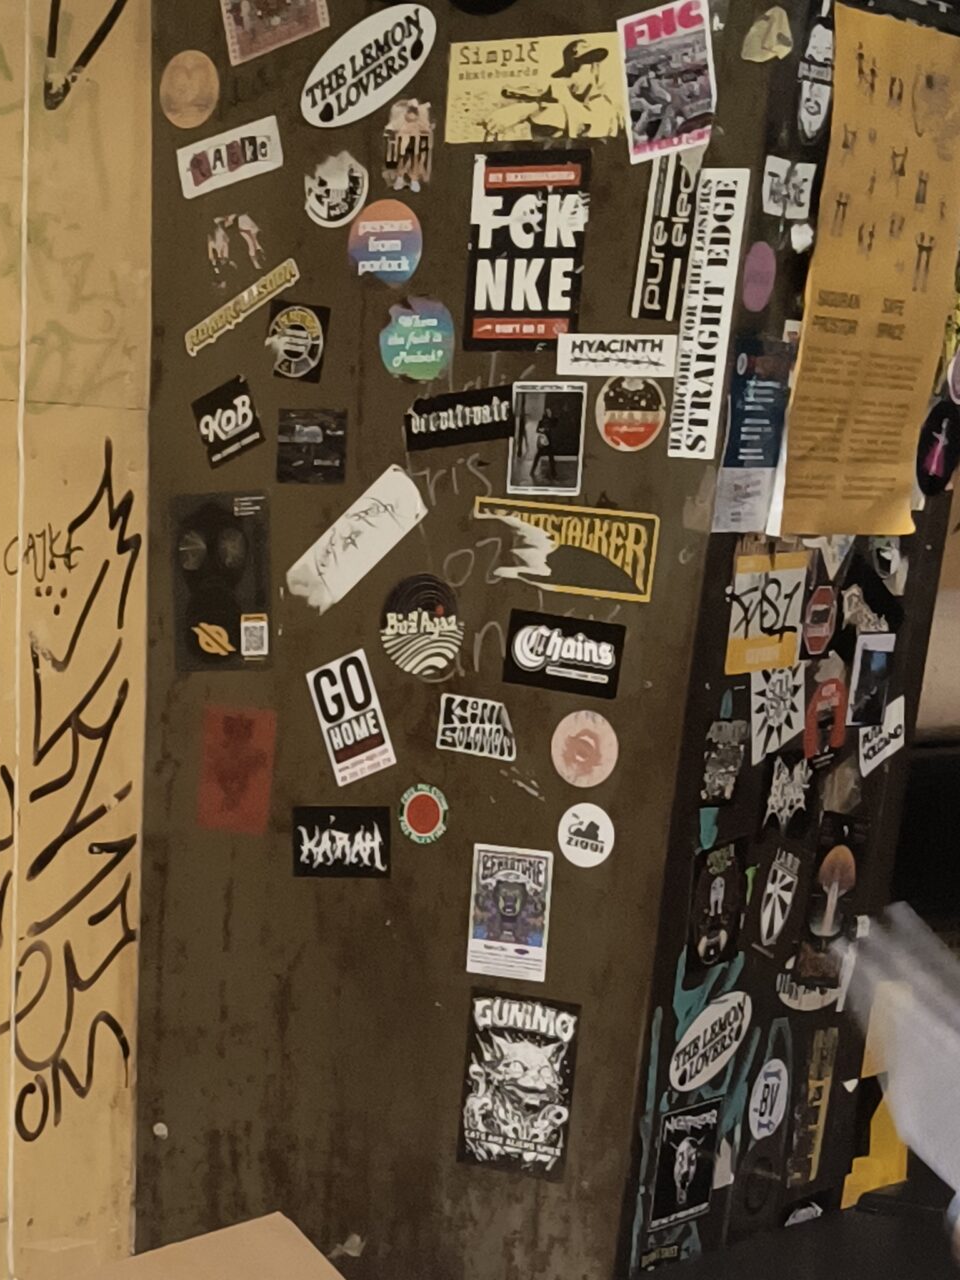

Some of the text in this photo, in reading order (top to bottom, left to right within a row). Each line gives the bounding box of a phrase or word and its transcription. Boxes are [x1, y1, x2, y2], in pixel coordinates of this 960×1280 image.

[306, 8, 423, 108] THE LEMON
[335, 46, 409, 116] LOVERS
[474, 258, 575, 311] NKE
[644, 220, 668, 310] pure
[688, 258, 703, 295] THE
[682, 305, 698, 341] FOR
[685, 180, 738, 453] STRAIGHT EDGE
[571, 339, 664, 353] HYACINTH
[199, 394, 254, 443] KOB
[669, 349, 693, 450] HARDCORE
[513, 624, 614, 668] Chains
[313, 655, 373, 723] GO
[328, 711, 380, 751] HOME
[674, 1002, 745, 1072] THE LEMON
[688, 1027, 735, 1082] LOVERS
